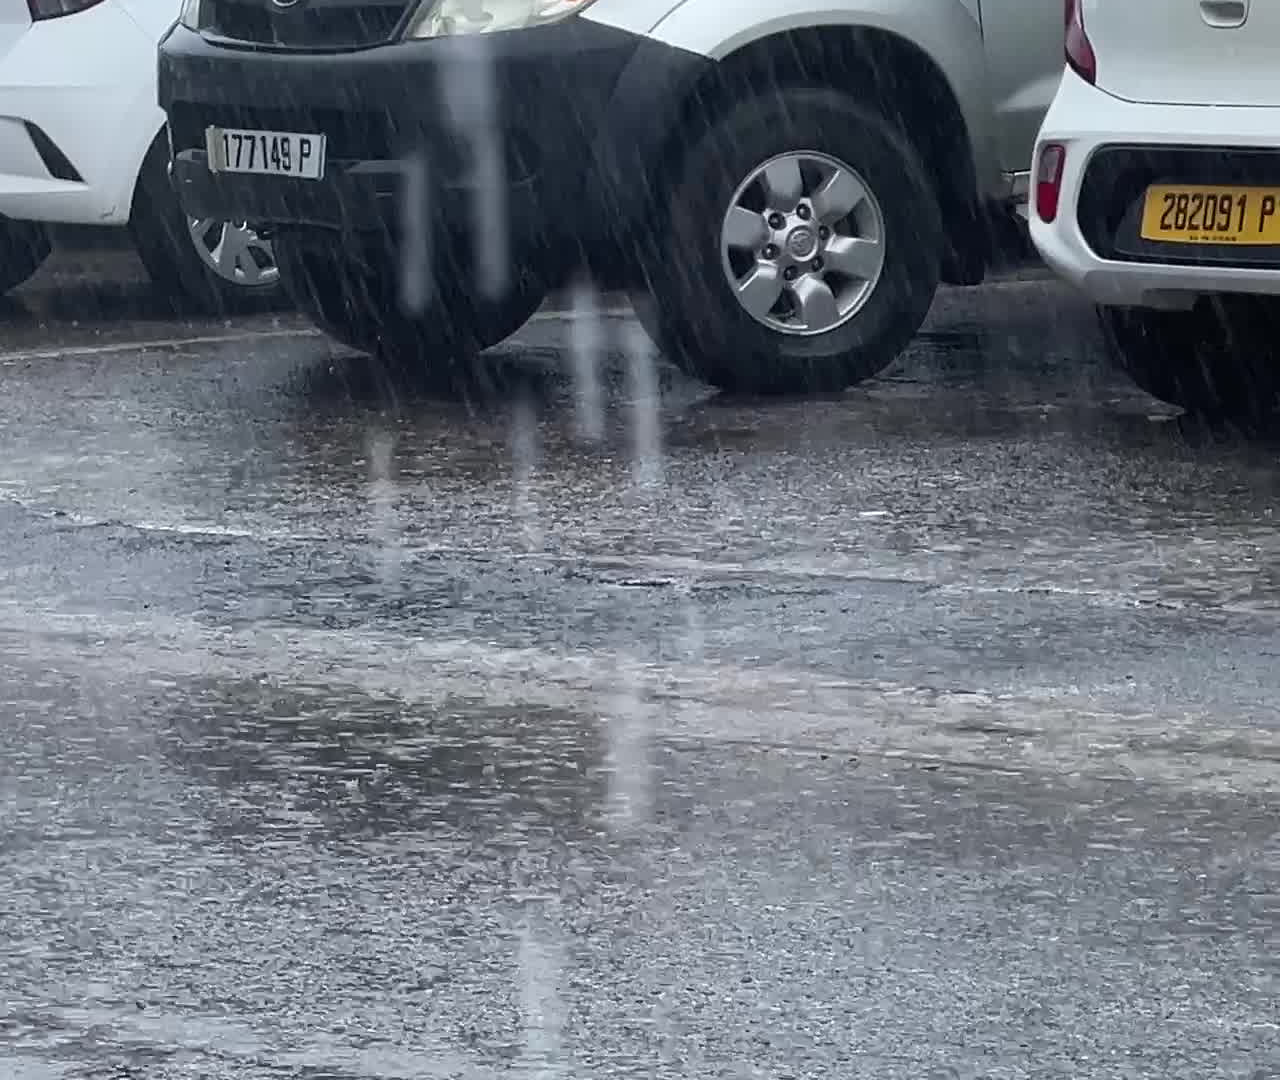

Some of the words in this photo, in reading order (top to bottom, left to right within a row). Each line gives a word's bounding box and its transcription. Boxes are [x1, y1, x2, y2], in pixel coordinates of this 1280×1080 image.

[224, 133, 292, 172] 177149
[299, 137, 312, 173] P
[1160, 193, 1248, 233] 282091
[1258, 194, 1276, 233] P
